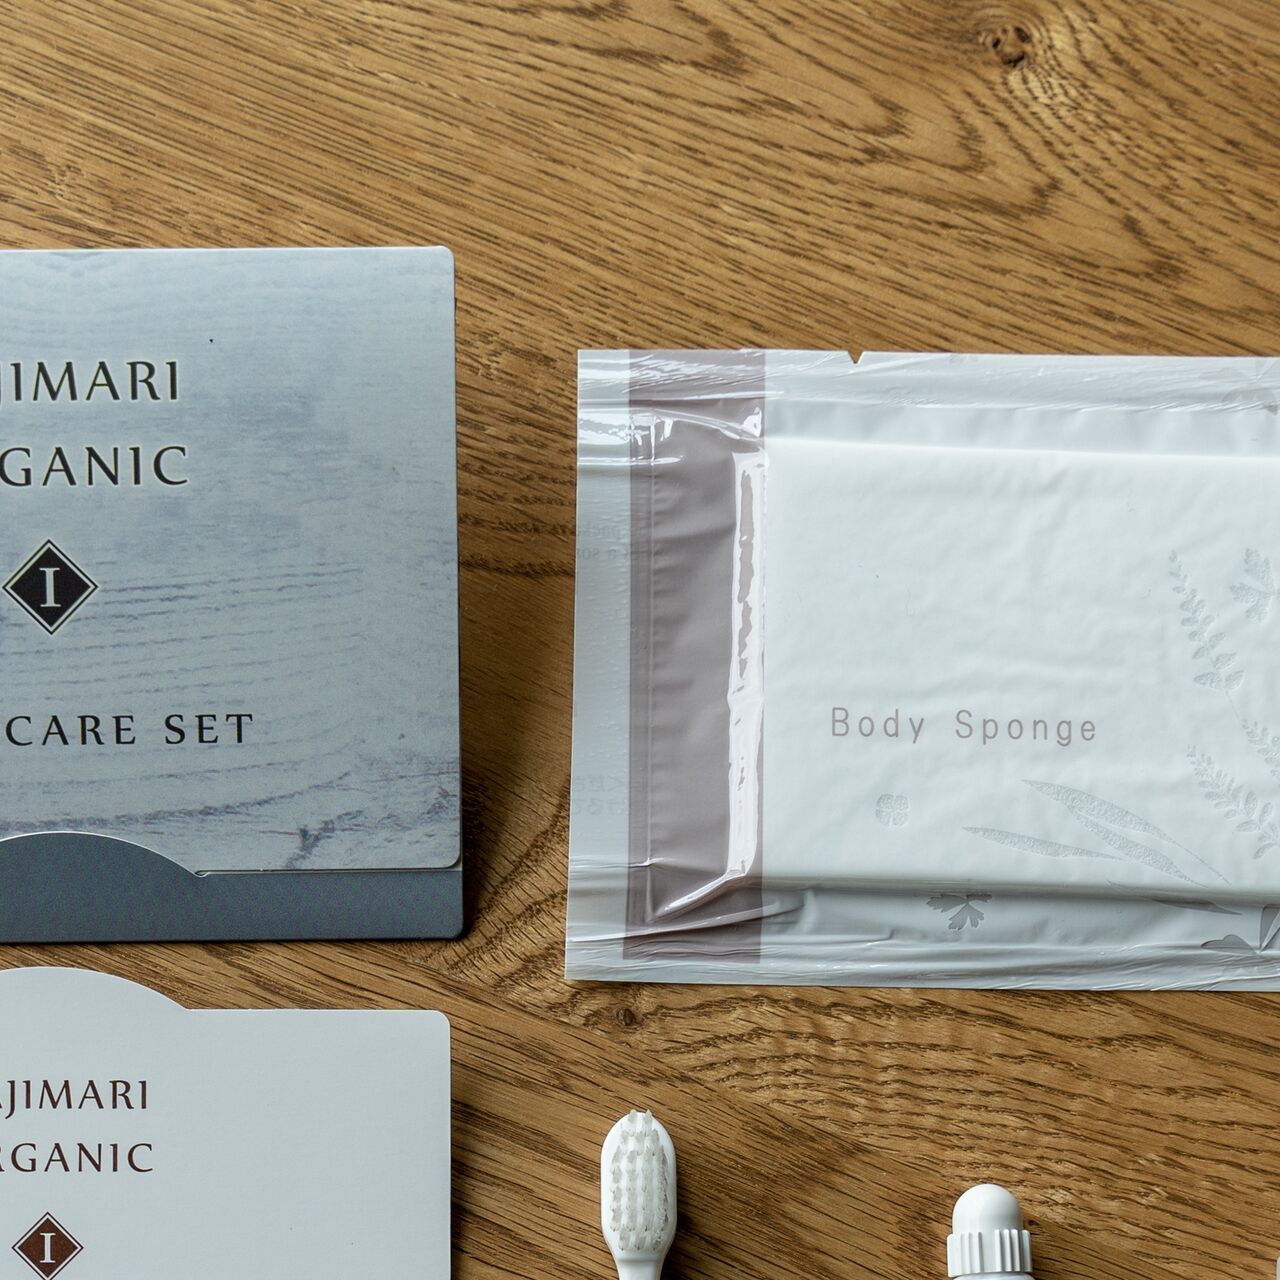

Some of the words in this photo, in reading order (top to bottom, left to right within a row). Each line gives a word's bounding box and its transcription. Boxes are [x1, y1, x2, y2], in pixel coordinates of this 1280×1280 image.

[5, 714, 136, 747] CARE
[164, 713, 253, 745] SET
[831, 706, 925, 744] Body
[955, 709, 1096, 748] Sponge
